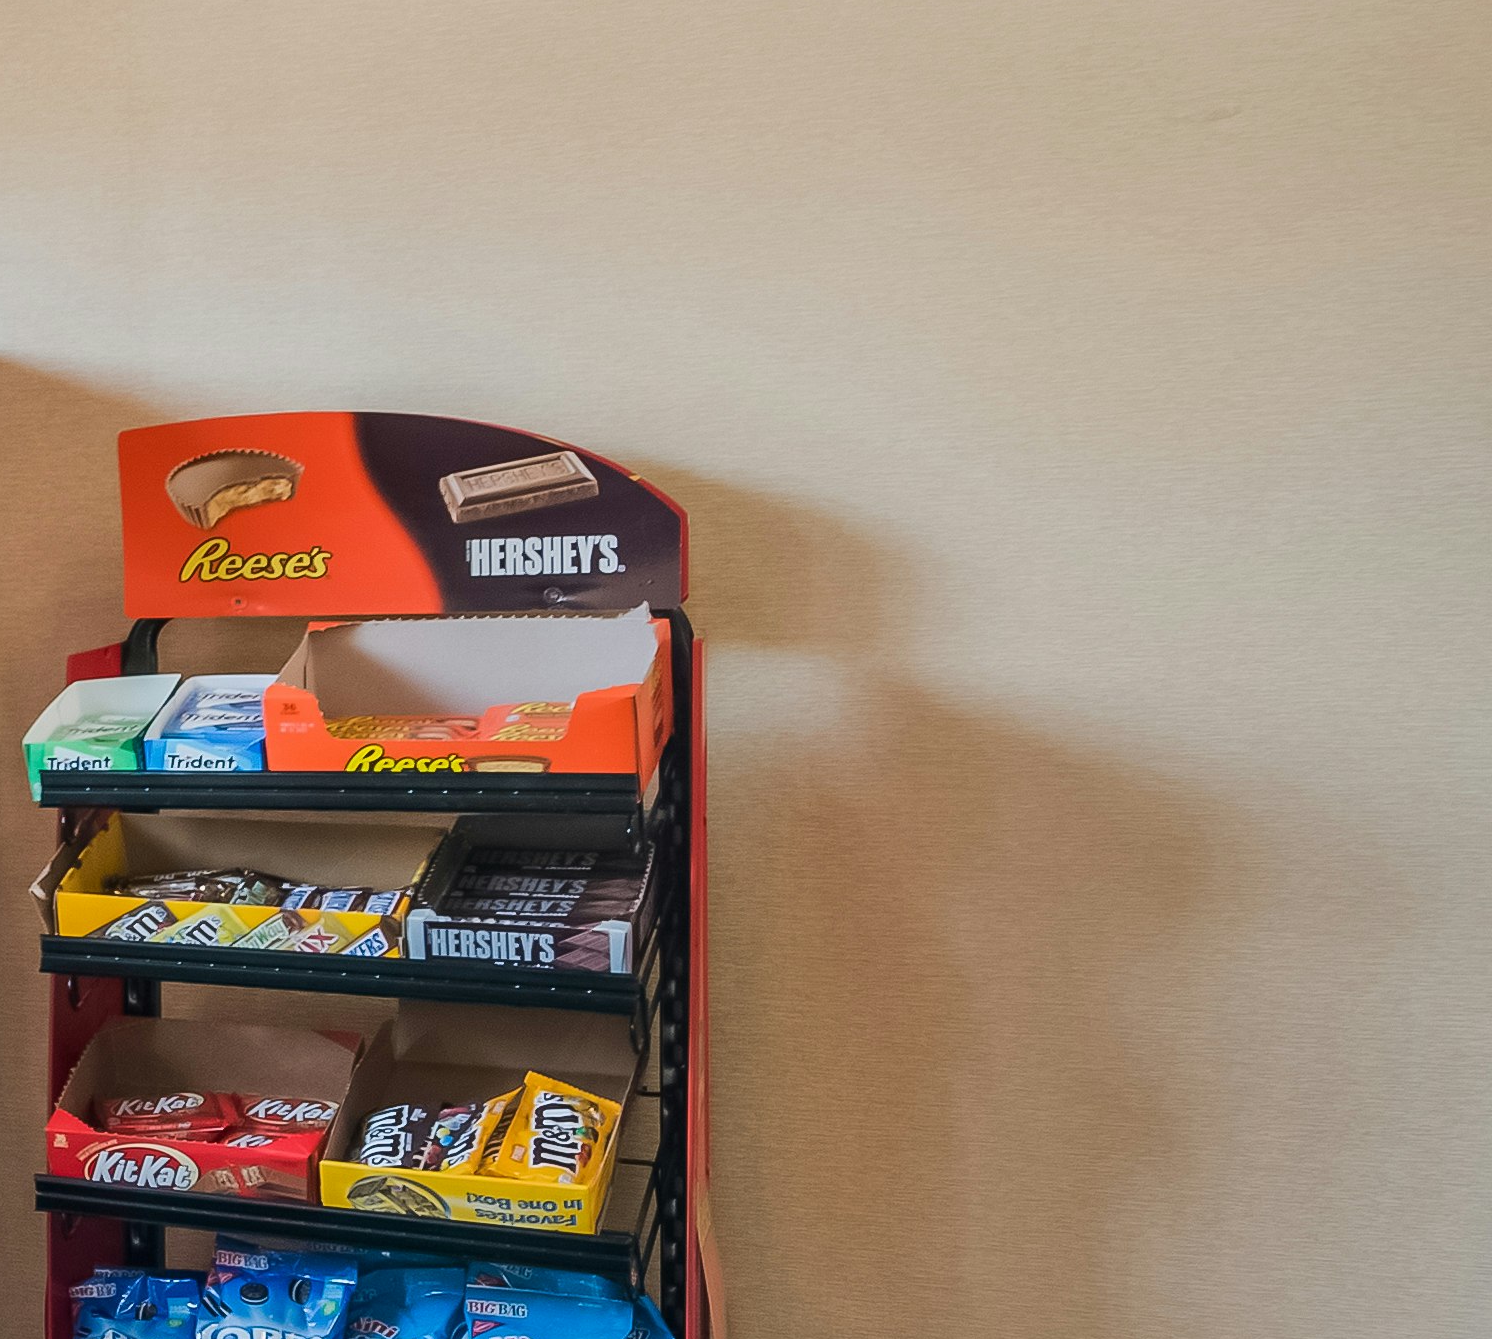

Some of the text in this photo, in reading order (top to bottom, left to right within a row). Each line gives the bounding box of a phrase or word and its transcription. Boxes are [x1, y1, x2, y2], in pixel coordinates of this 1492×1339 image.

[179, 536, 333, 583] Reese's
[470, 534, 620, 577] HERSHEY'S
[47, 755, 112, 771] Trident
[167, 753, 236, 770] Trident
[344, 744, 466, 773] Reese's
[431, 928, 555, 963] HERSHEY'S
[466, 1192, 583, 1213] In One Box!
[476, 1209, 577, 1227] Favorites
[216, 1250, 243, 1267] BIG
[467, 1300, 528, 1318] BIG BAG
